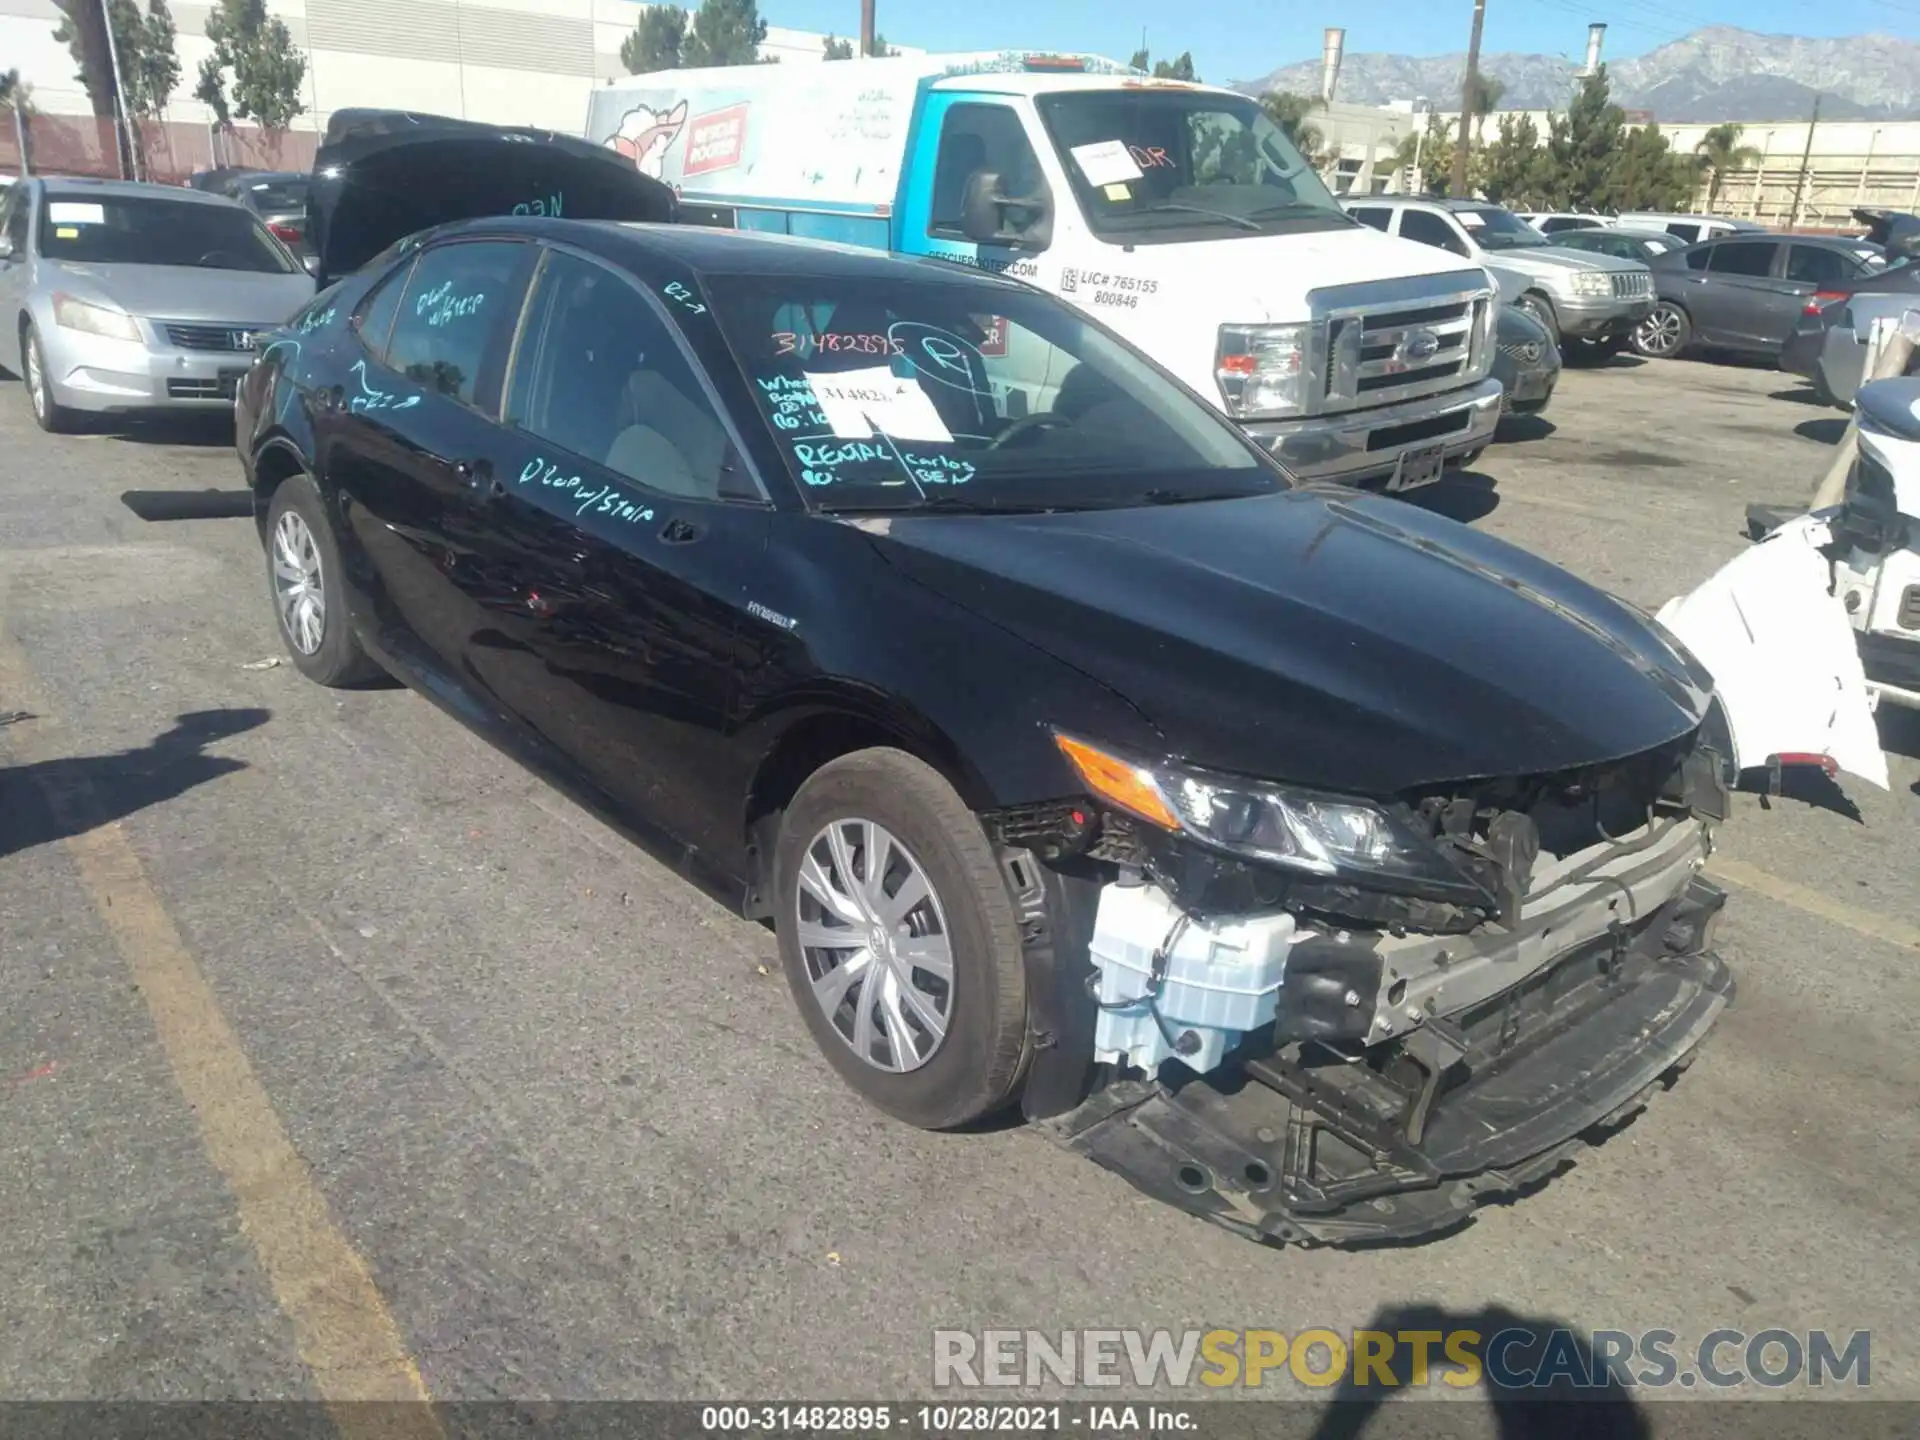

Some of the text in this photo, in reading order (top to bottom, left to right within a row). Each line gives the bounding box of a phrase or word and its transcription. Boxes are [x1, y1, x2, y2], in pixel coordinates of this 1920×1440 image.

[1080, 270, 1110, 287] LIC#
[1112, 274, 1158, 293] 765155
[1094, 290, 1139, 309] 800846
[771, 332, 905, 355] 31482895
